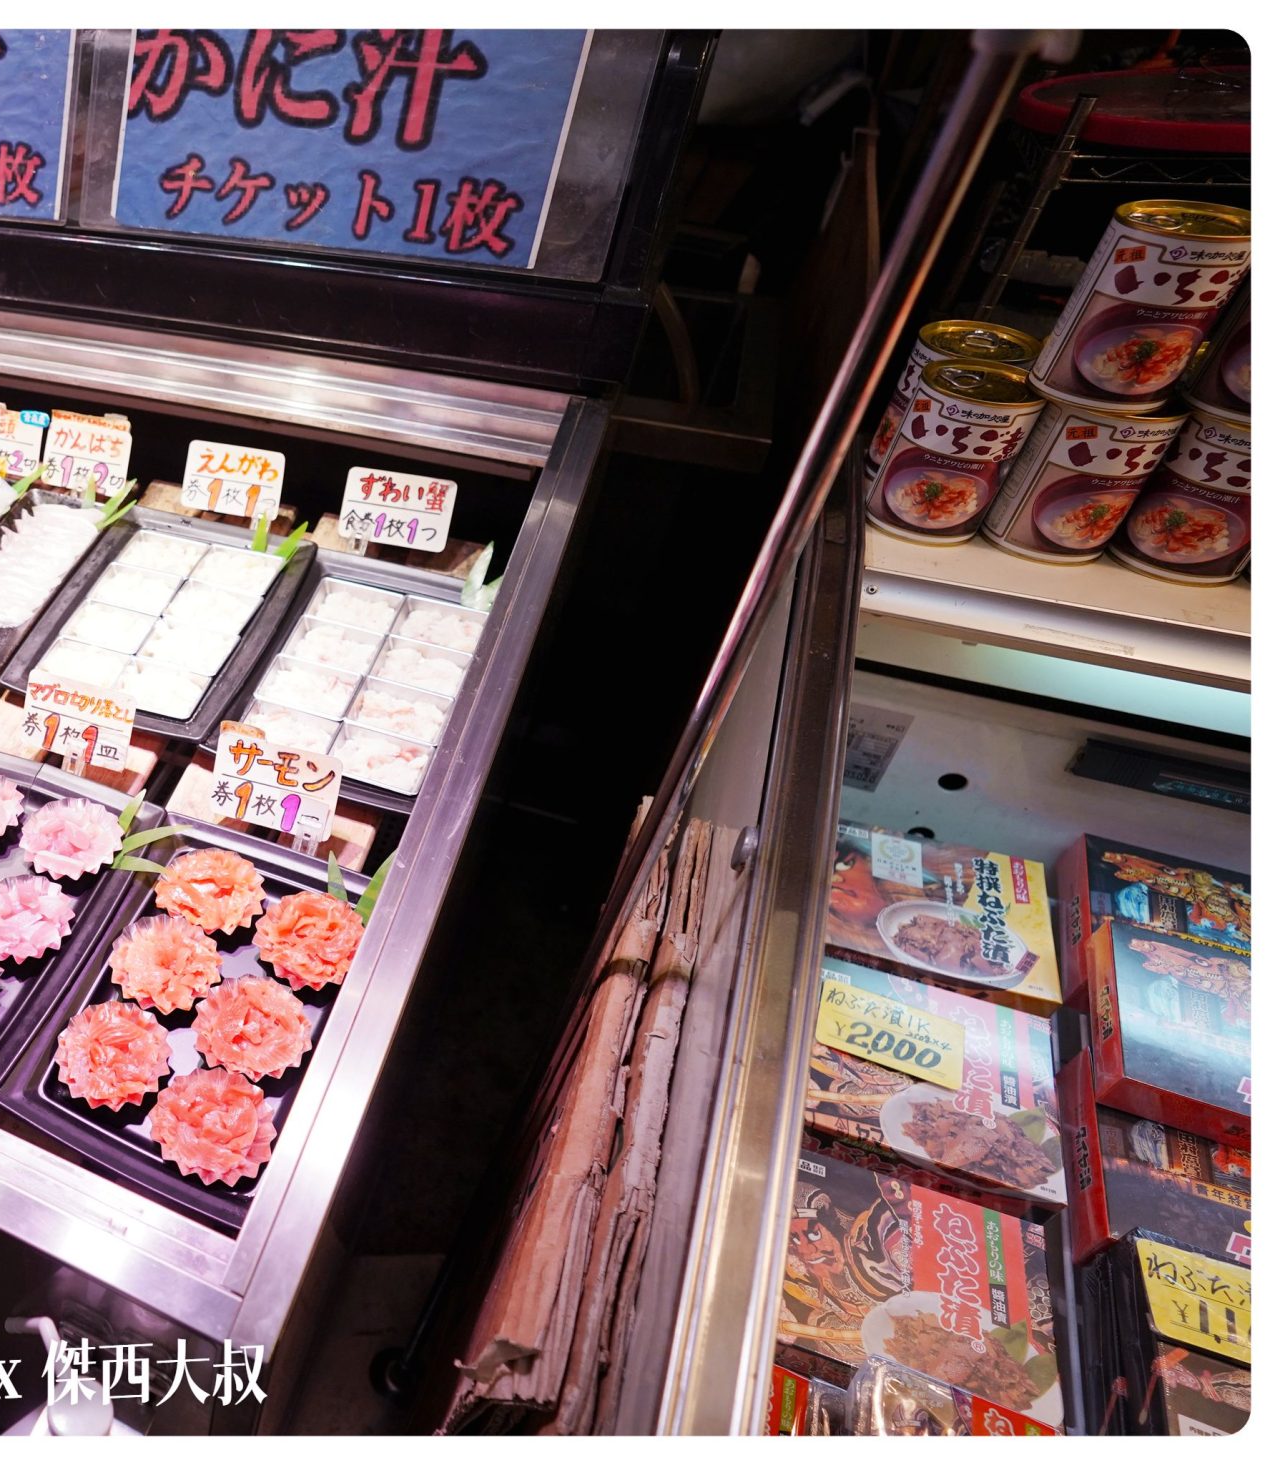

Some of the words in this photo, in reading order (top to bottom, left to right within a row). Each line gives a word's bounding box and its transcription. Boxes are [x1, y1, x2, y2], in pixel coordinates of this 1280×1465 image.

[161, 152, 523, 257] チケット1枚
[197, 449, 278, 481] えんがわ
[360, 472, 449, 512] ずわい蟹
[229, 739, 336, 792] サーモン
